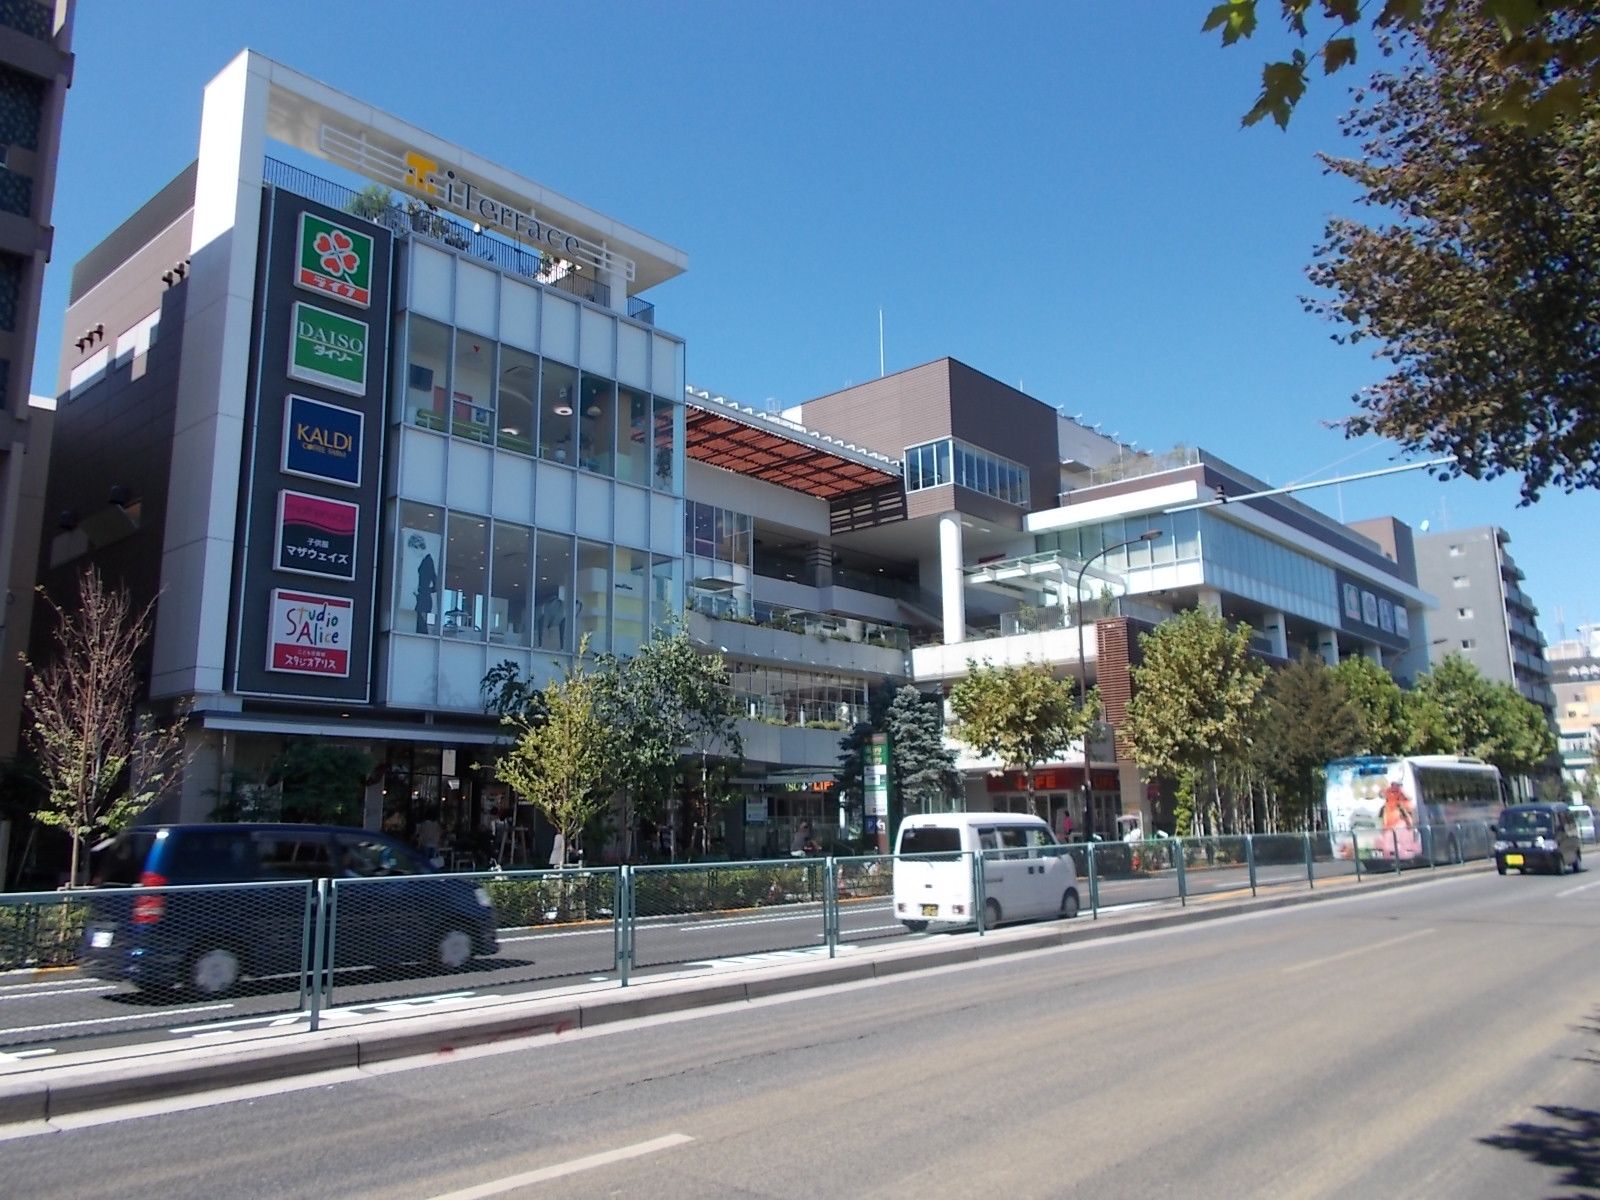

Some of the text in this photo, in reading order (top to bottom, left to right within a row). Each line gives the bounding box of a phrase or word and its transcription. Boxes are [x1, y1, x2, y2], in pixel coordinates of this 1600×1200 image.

[446, 170, 580, 256] iTerrace
[313, 275, 356, 297] ライフ
[299, 321, 364, 353] DAISO
[313, 344, 353, 362] ダイソー
[296, 423, 353, 452] KALDI
[286, 545, 349, 564] マザウェイズ
[286, 602, 339, 636] Studio
[296, 621, 339, 646] Alice
[284, 654, 337, 670] スタジオアリス
[1017, 775, 1056, 790] LFE
